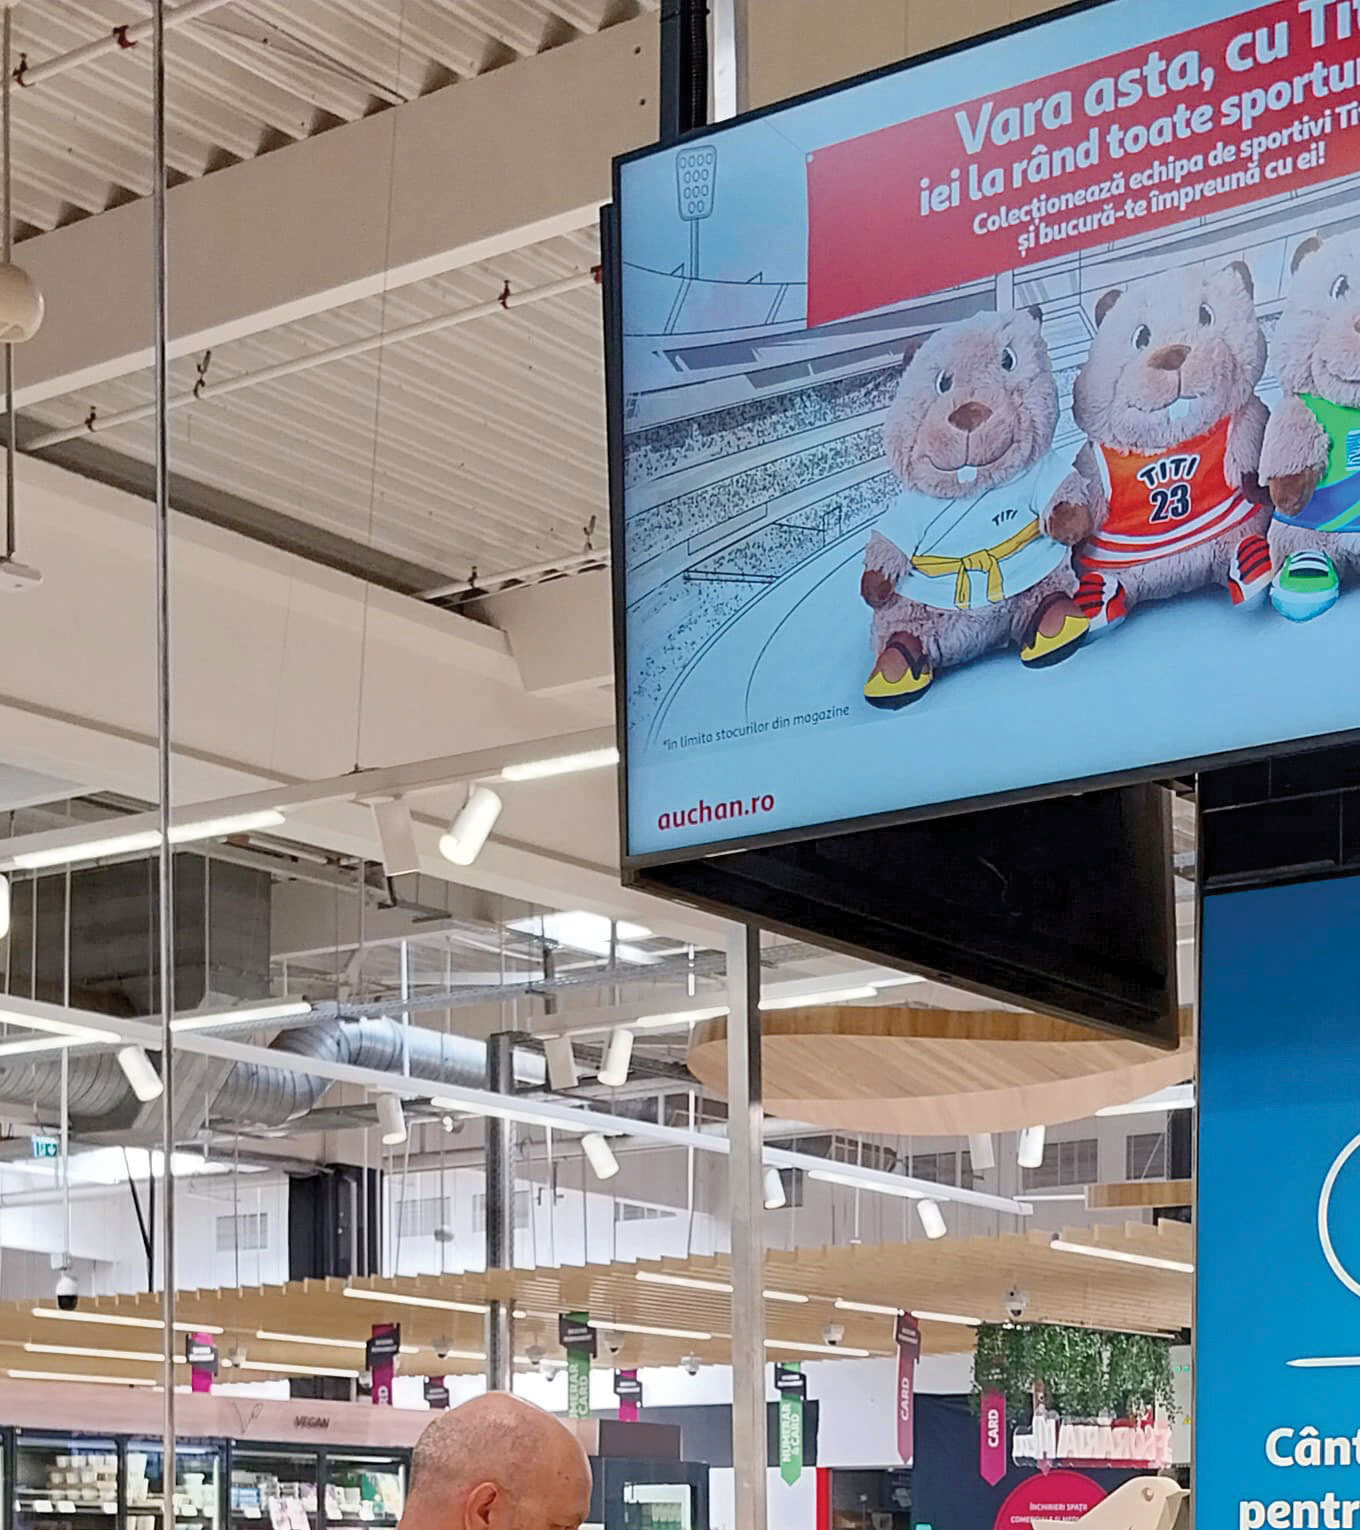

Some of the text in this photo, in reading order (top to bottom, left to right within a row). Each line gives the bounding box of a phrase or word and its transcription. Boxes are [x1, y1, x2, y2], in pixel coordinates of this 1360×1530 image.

[954, 101, 1072, 155] Vara
[1083, 50, 1215, 117] asta,
[1225, 21, 1289, 72] cu
[919, 167, 960, 216] iei
[968, 163, 1005, 201] la
[1012, 144, 1100, 189] rând
[1106, 103, 1214, 159] toate
[972, 171, 1125, 235] Colecționează
[1128, 154, 1204, 190] echipa
[1207, 142, 1237, 167] de
[1240, 108, 1333, 163] sportivi
[1017, 140, 1326, 258] și bucură-te împreună cu ei!
[1137, 453, 1201, 490] TITI
[1148, 486, 1191, 523] 23
[715, 720, 770, 741] stocurilor
[771, 715, 791, 730] din
[793, 705, 851, 727] magazine
[658, 793, 776, 831] auchan.ro
[900, 1377, 910, 1422] CARD
[293, 1415, 331, 1429] VEGAN
[988, 1408, 999, 1448] CARD
